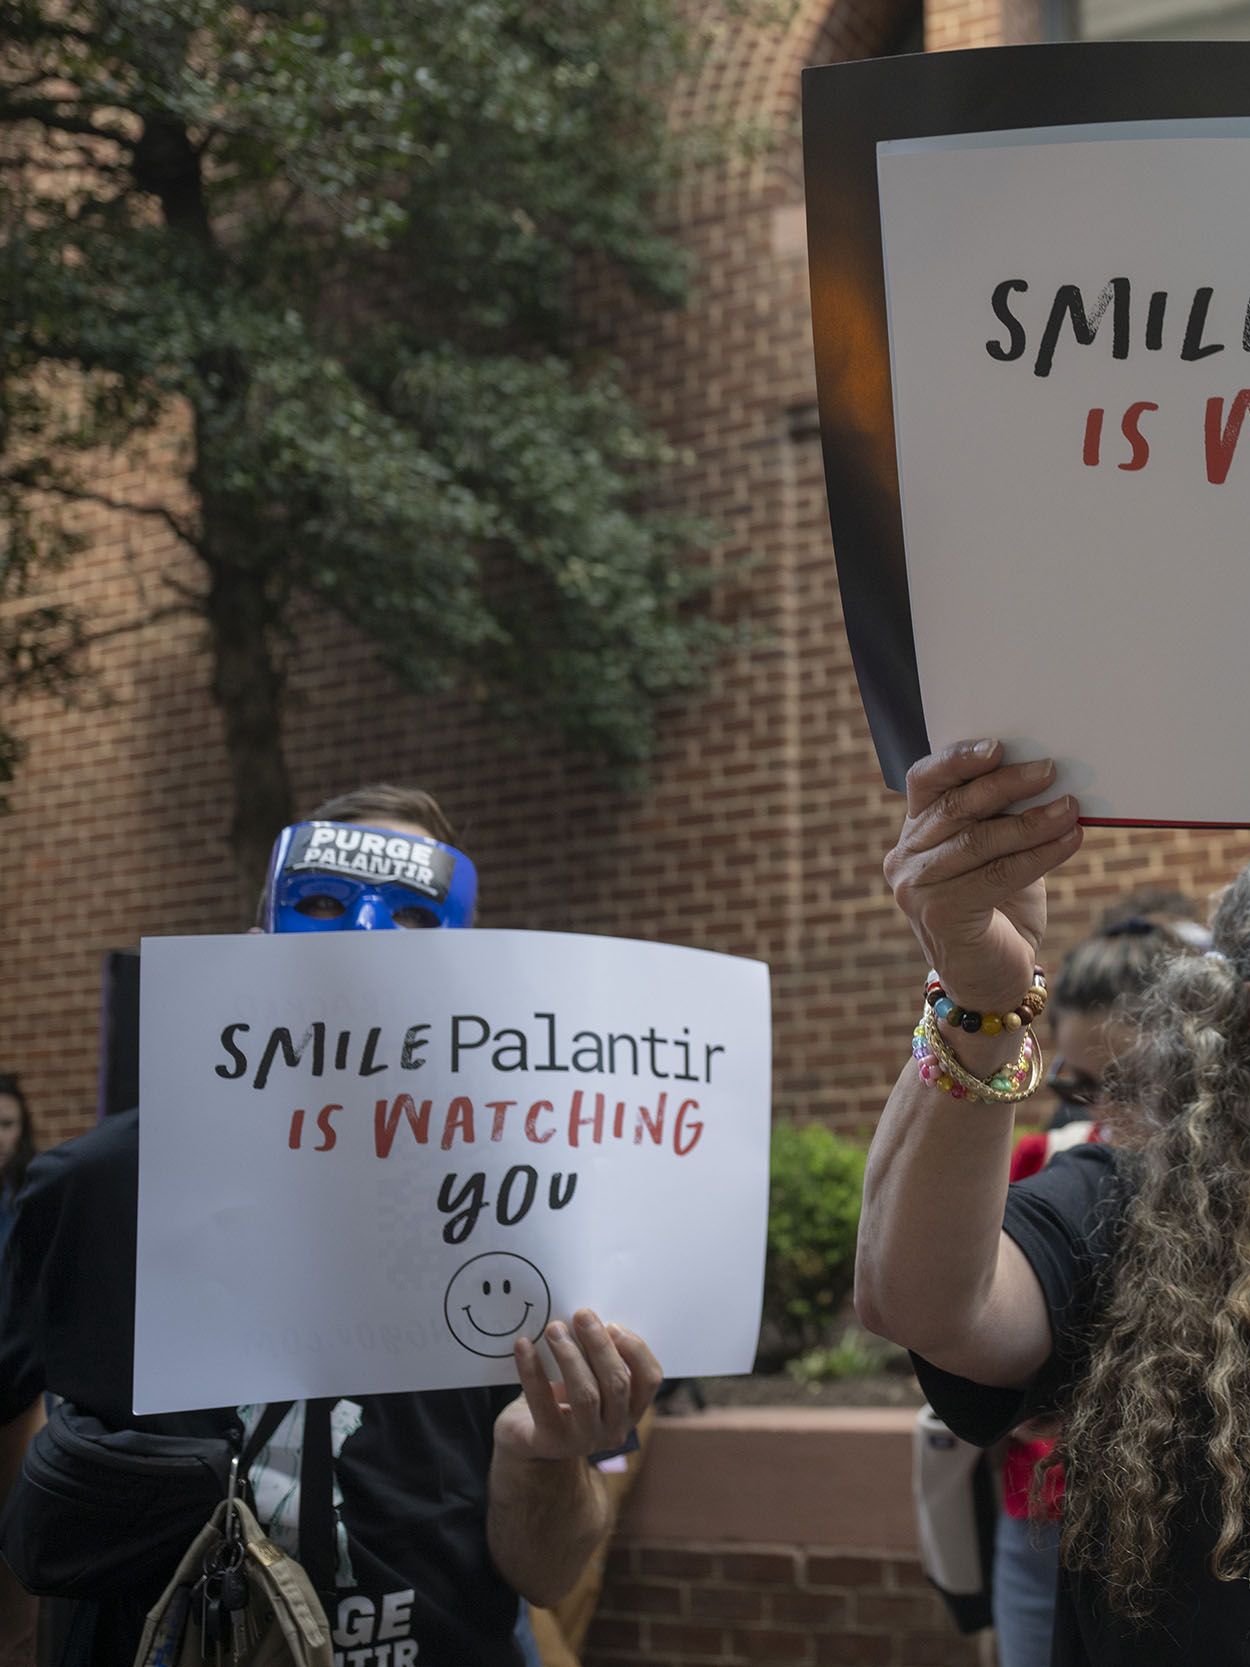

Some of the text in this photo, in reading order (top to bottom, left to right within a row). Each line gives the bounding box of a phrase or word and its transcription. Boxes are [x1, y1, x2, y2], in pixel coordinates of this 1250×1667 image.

[1083, 402, 1159, 472] IS
[303, 847, 434, 886] PALANTIR
[309, 828, 433, 866] PURGE
[214, 1013, 725, 1091] SMILE Palantir
[288, 1090, 705, 1158] IS WATCHING
